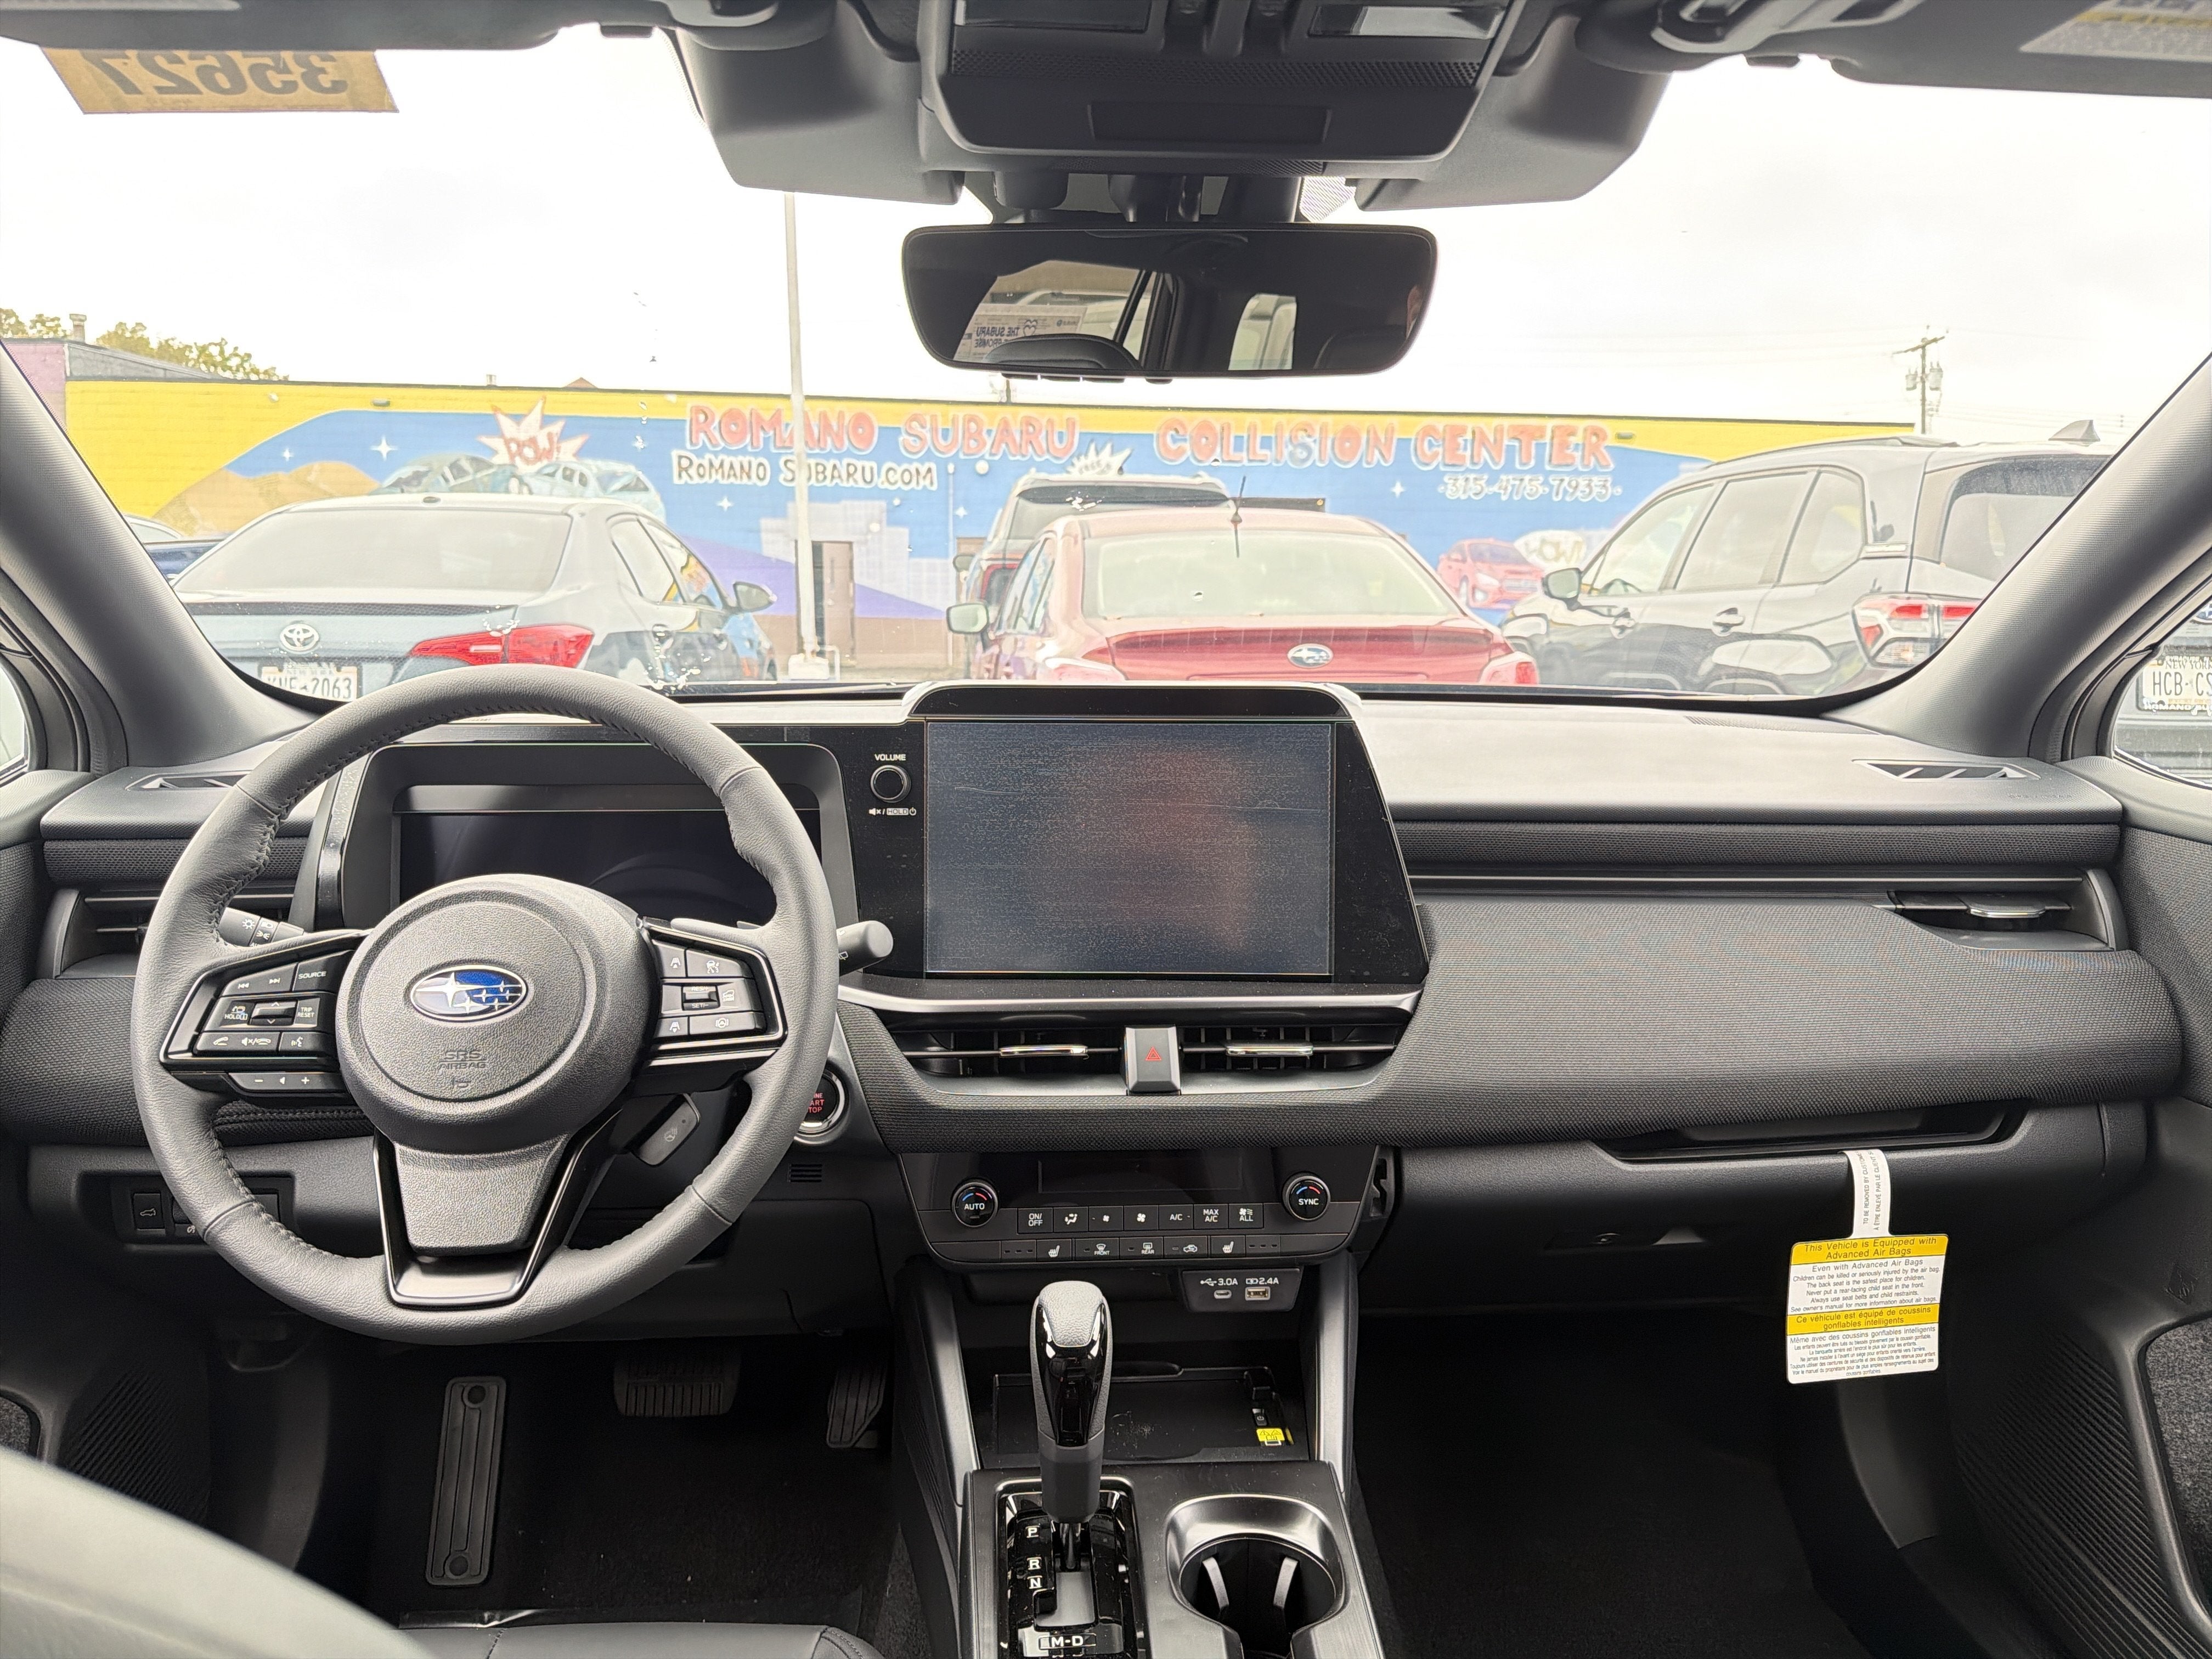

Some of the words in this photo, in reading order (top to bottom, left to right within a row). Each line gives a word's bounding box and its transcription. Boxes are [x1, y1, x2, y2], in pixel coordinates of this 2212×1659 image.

[689, 405, 876, 452] ROMANO
[900, 413, 1077, 459] SUBARU
[1156, 417, 1396, 467] COLLISION
[1415, 424, 1613, 469] CENTER
[2152, 671, 2183, 696] HCB
[298, 971, 327, 980] SOURCE
[444, 1050, 483, 1060] SRS
[1298, 1198, 1319, 1206] SYNC
[1827, 1242, 1858, 1250] Vehicle
[1874, 1238, 1915, 1248] Equipped
[1826, 1250, 1869, 1260] Advanced
[1889, 1248, 1911, 1256] Bags
[1852, 1261, 1888, 1269] Advanced
[1217, 1278, 1238, 1286] 3.0A
[1810, 1313, 1841, 1322] véhicule
[1859, 1310, 1883, 1319] équipé
[1899, 1307, 1931, 1315] coussins
[1824, 1321, 1861, 1331] gonflables
[1865, 1317, 1904, 1326] intelligents
[1028, 1527, 1038, 1536] P
[1029, 1559, 1040, 1569] R
[1030, 1577, 1041, 1586] N
[1051, 1635, 1084, 1647] M-D
